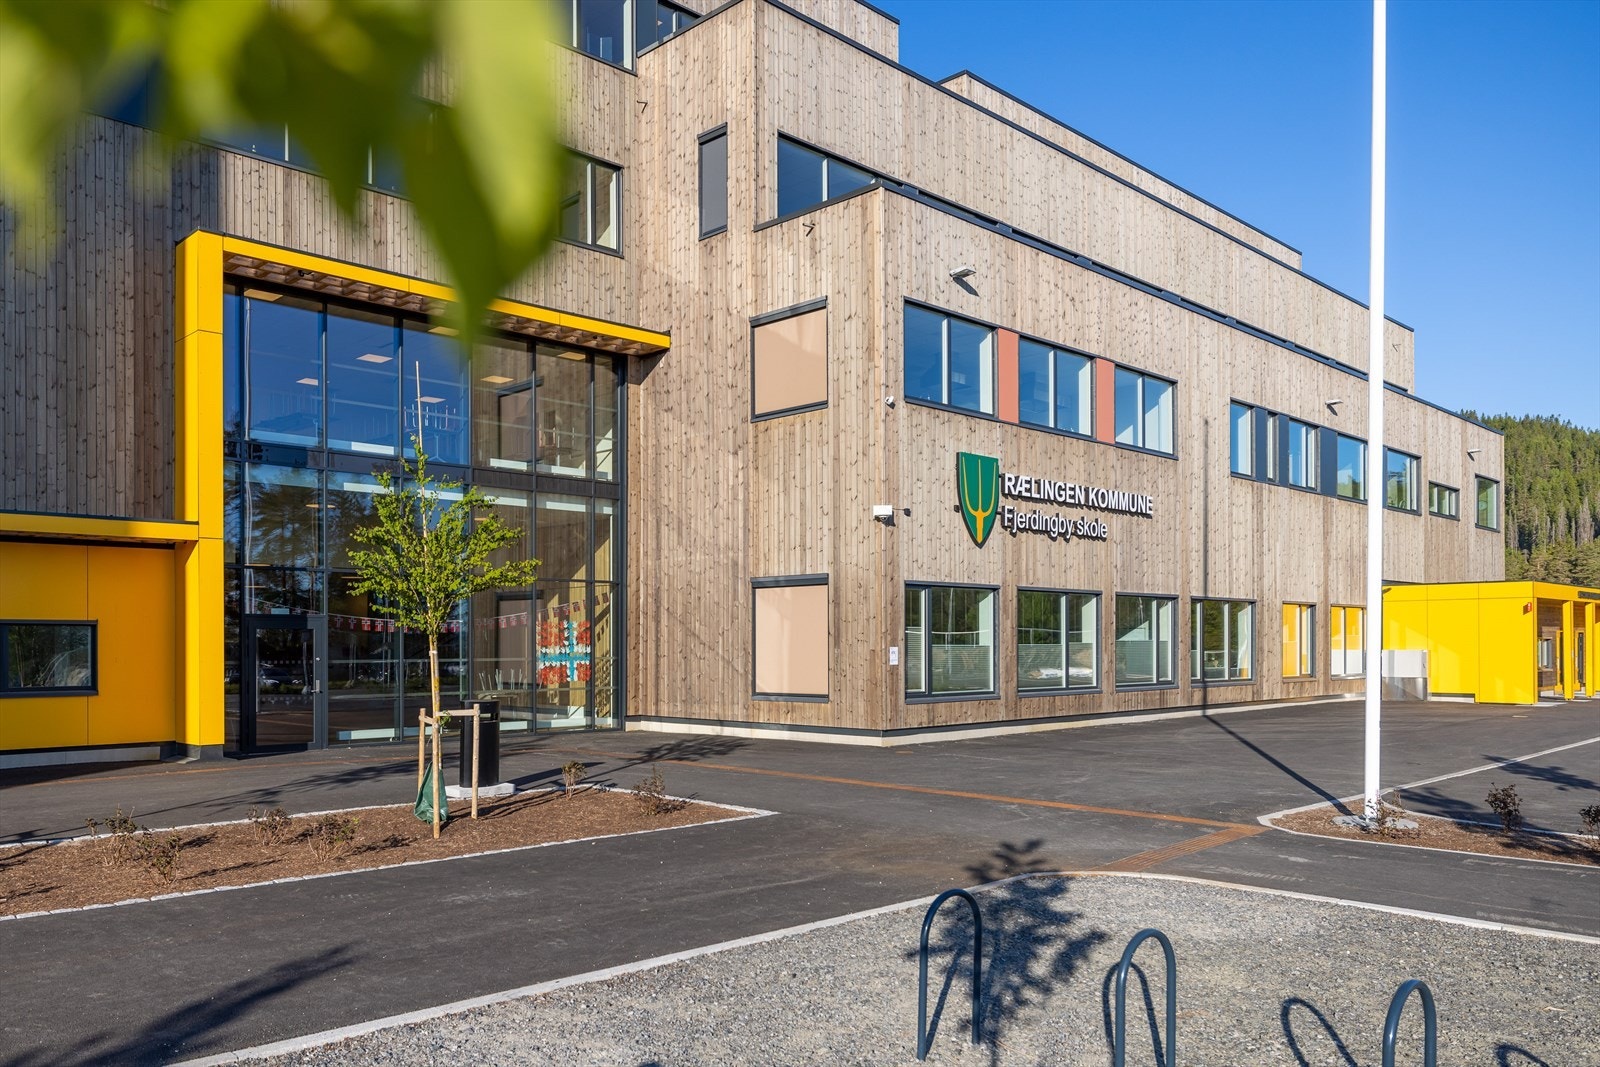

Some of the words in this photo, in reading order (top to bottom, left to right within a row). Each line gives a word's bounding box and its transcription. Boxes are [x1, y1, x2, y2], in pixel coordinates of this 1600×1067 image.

[1004, 473, 1085, 505] RÆLINGEN
[1088, 487, 1154, 515] KOMMUNE
[1004, 505, 1074, 539] Fjerdingby
[1077, 516, 1108, 538] skole
